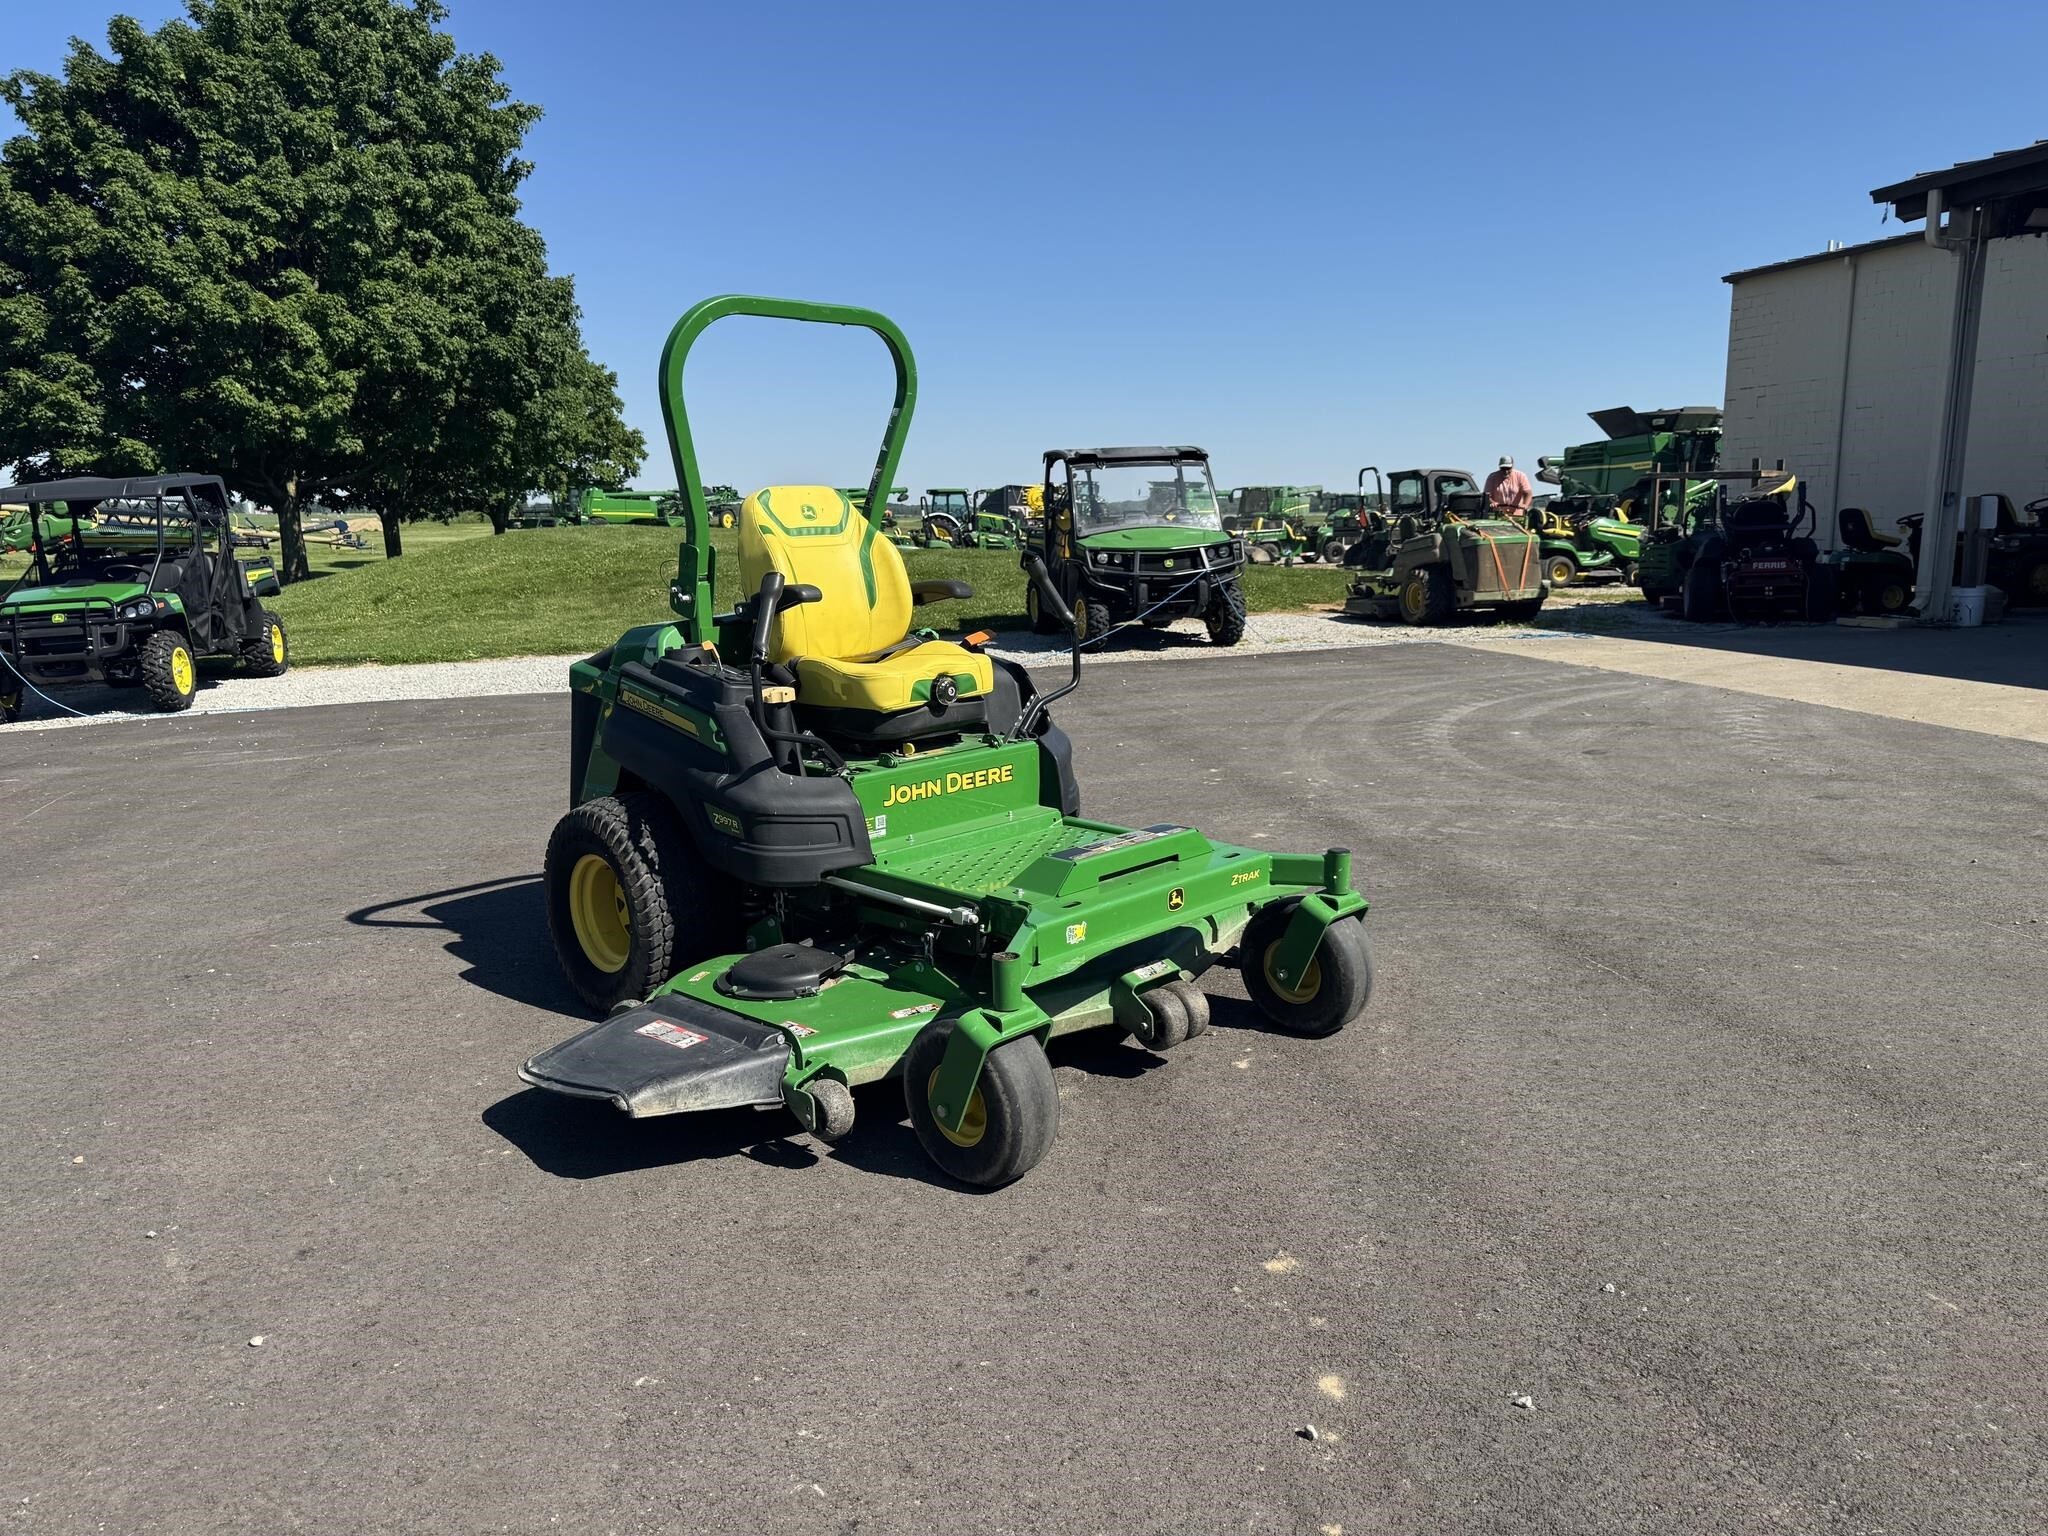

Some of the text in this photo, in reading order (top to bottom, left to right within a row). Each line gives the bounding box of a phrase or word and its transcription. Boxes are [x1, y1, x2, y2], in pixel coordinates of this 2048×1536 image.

[1752, 561, 1787, 569] FERRIS
[625, 694, 642, 710] JOHN
[883, 764, 1013, 807] JOHN DEERE
[1231, 868, 1261, 886] ZTRAK
